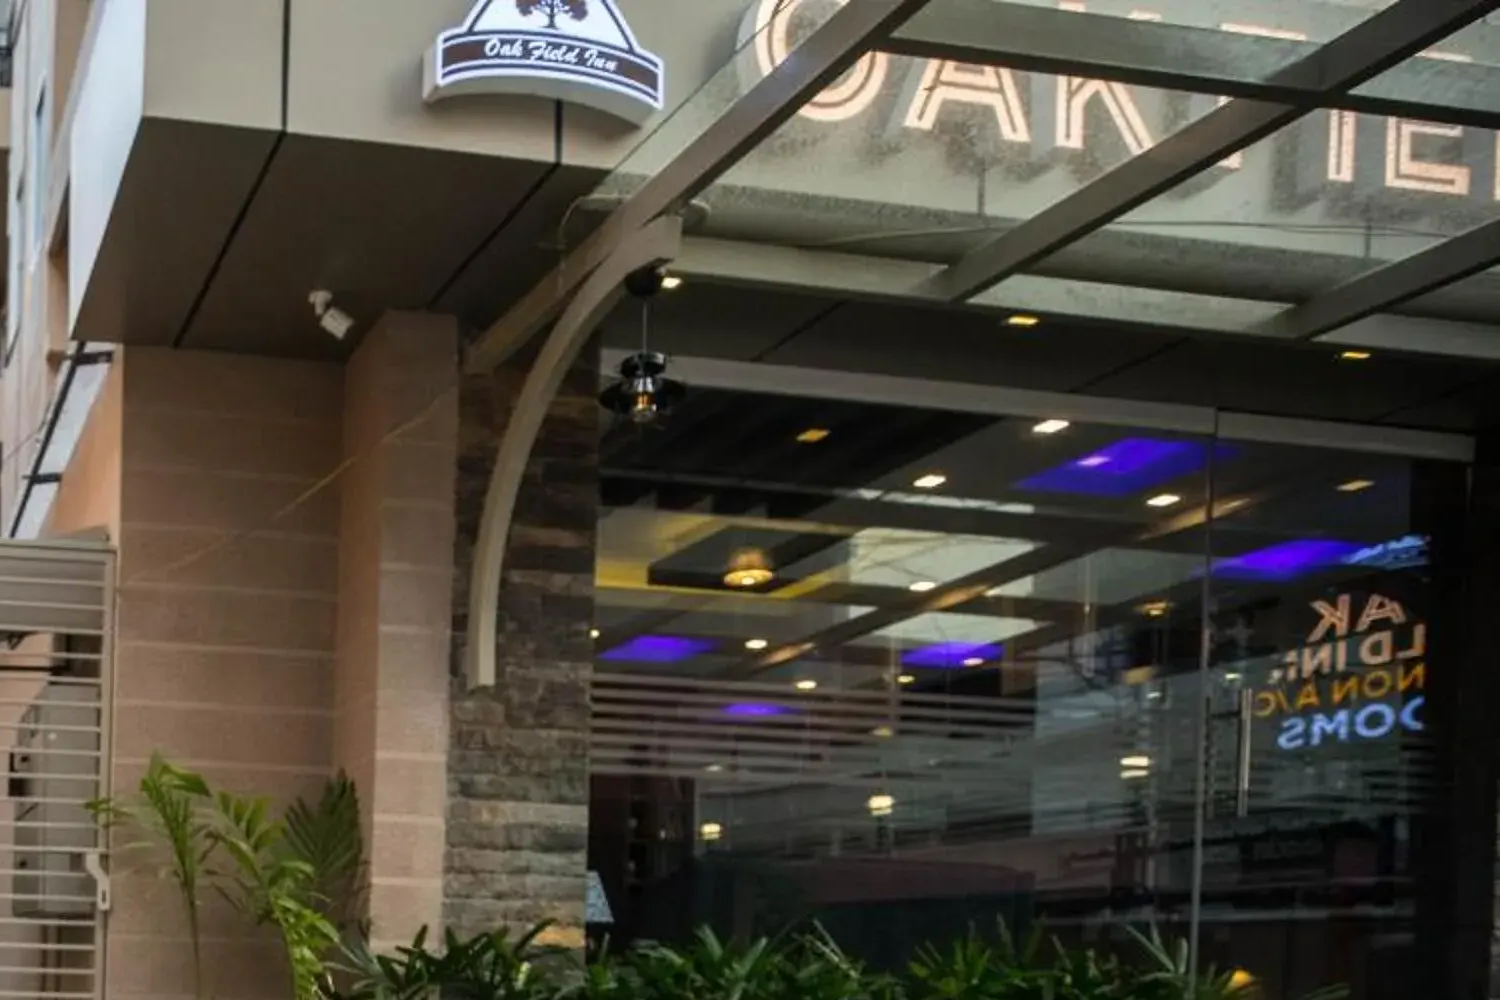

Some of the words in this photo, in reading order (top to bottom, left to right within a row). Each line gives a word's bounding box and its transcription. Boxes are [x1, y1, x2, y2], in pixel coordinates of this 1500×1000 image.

[484, 37, 523, 58] Oak
[525, 41, 579, 65] Field
[583, 46, 620, 72] Inn
[756, 0, 1165, 154] OAK
